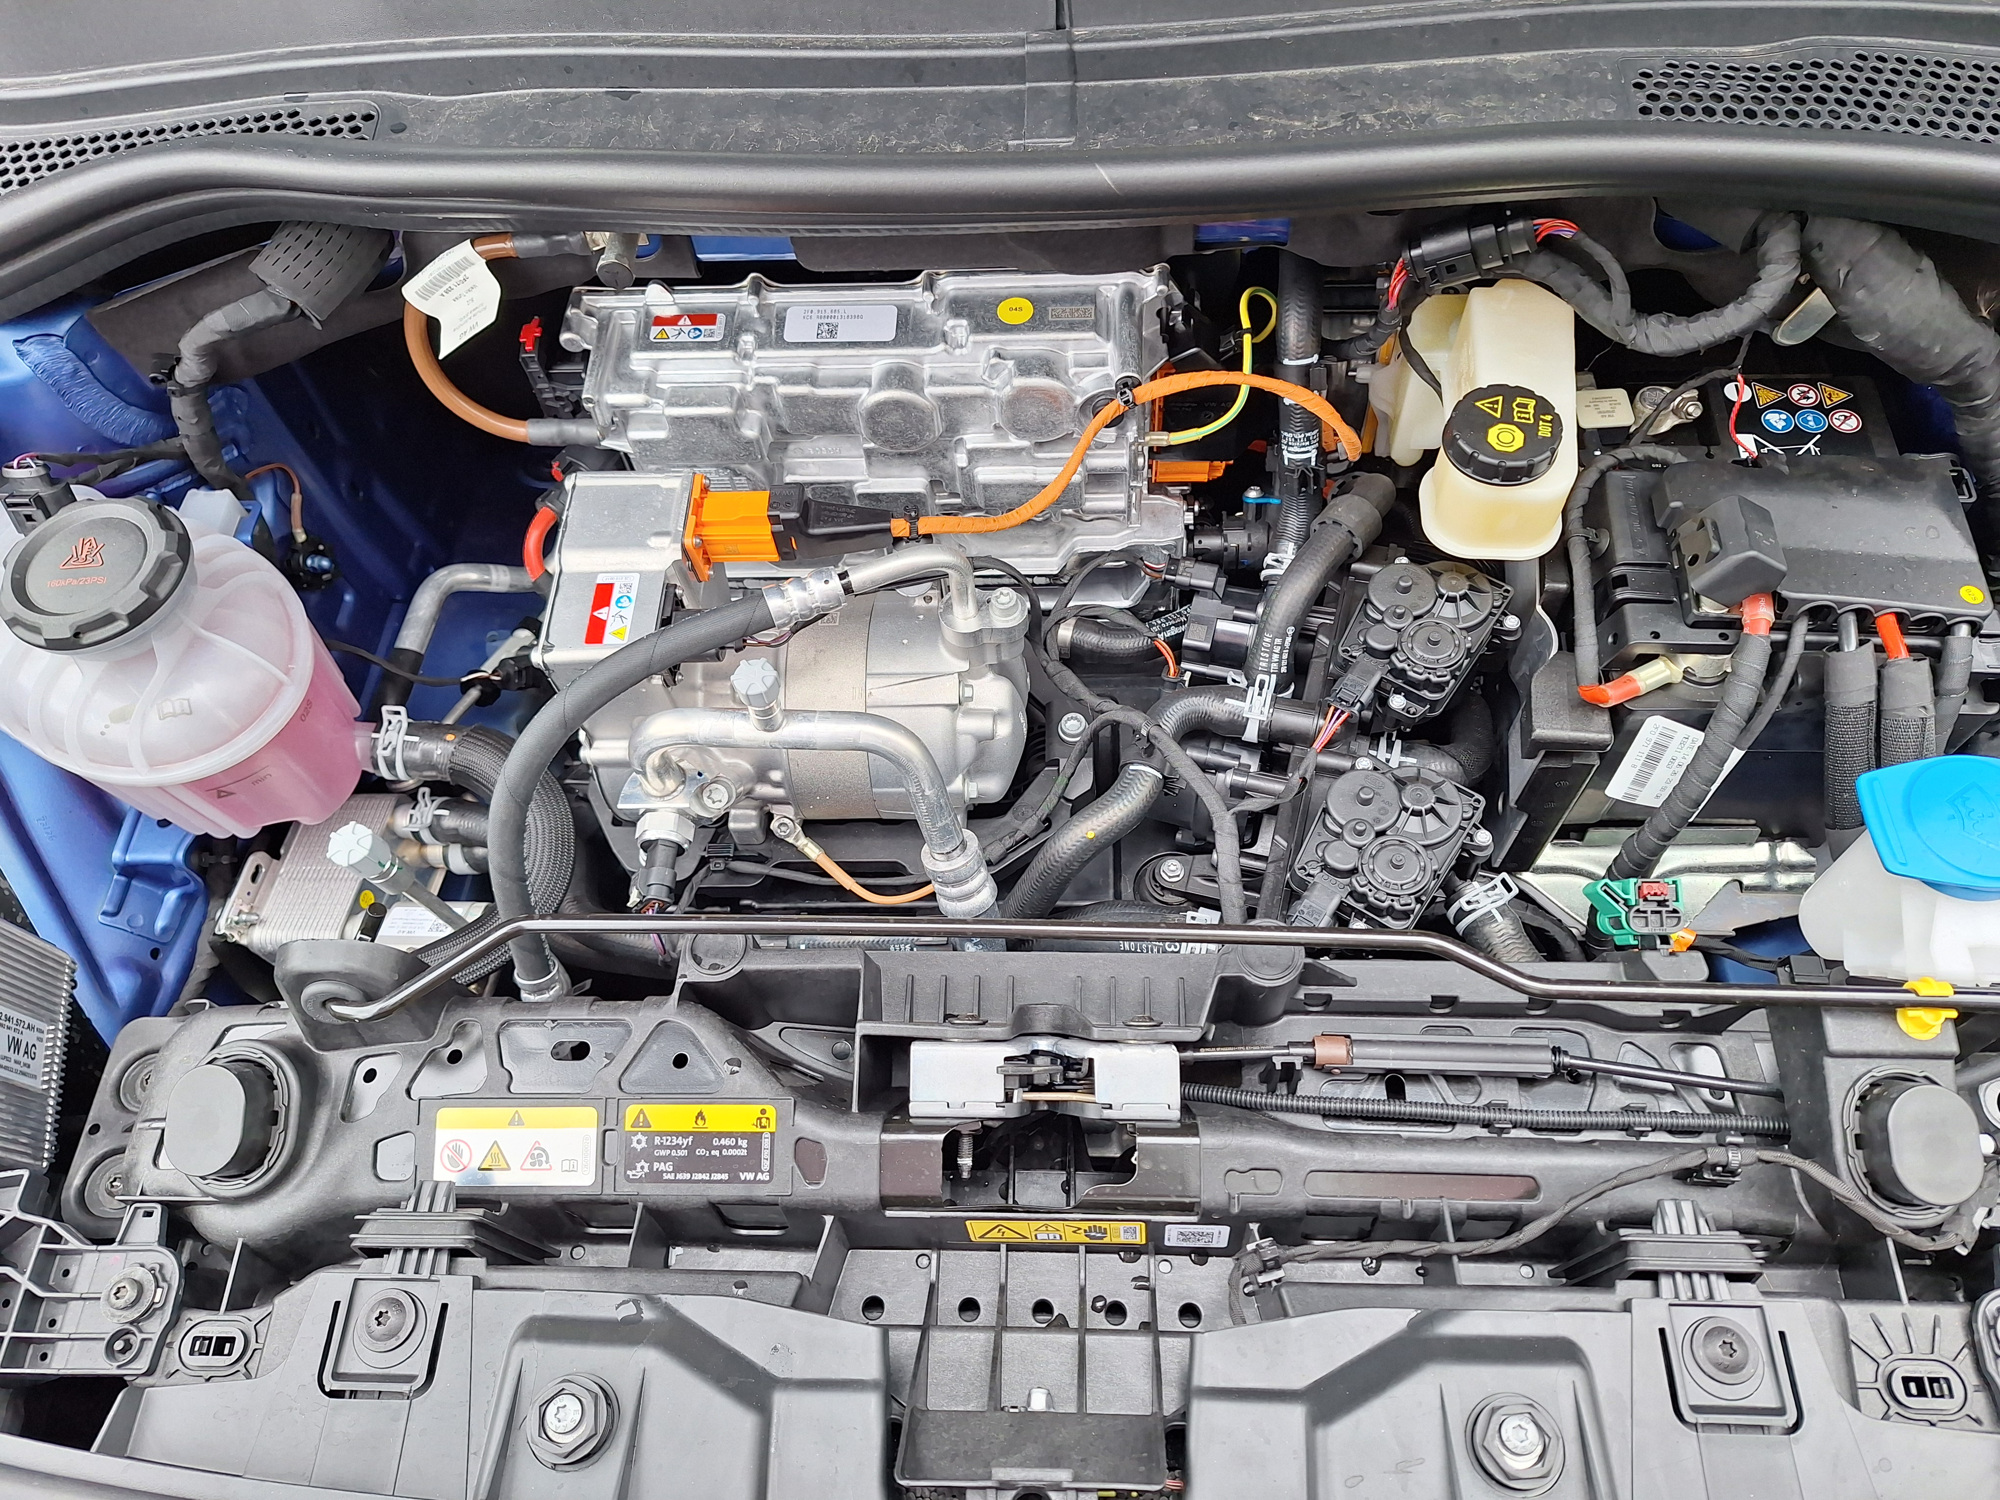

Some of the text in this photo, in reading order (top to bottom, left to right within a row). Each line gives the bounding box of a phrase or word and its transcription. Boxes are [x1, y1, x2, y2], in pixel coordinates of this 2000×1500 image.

[1537, 420, 1553, 438] DOT
[46, 575, 108, 588] 160kPa/23PSI
[1258, 632, 1273, 671] TRISTONE
[250, 772, 273, 787] min
[7, 1034, 23, 1056] VW
[22, 1041, 38, 1061] AG
[654, 1136, 748, 1148] R-1234yf 0.460 kg
[711, 1149, 720, 1157] eq
[653, 1161, 674, 1172] PAG
[662, 1172, 675, 1180] SAE
[740, 1172, 770, 1181] VW AG
